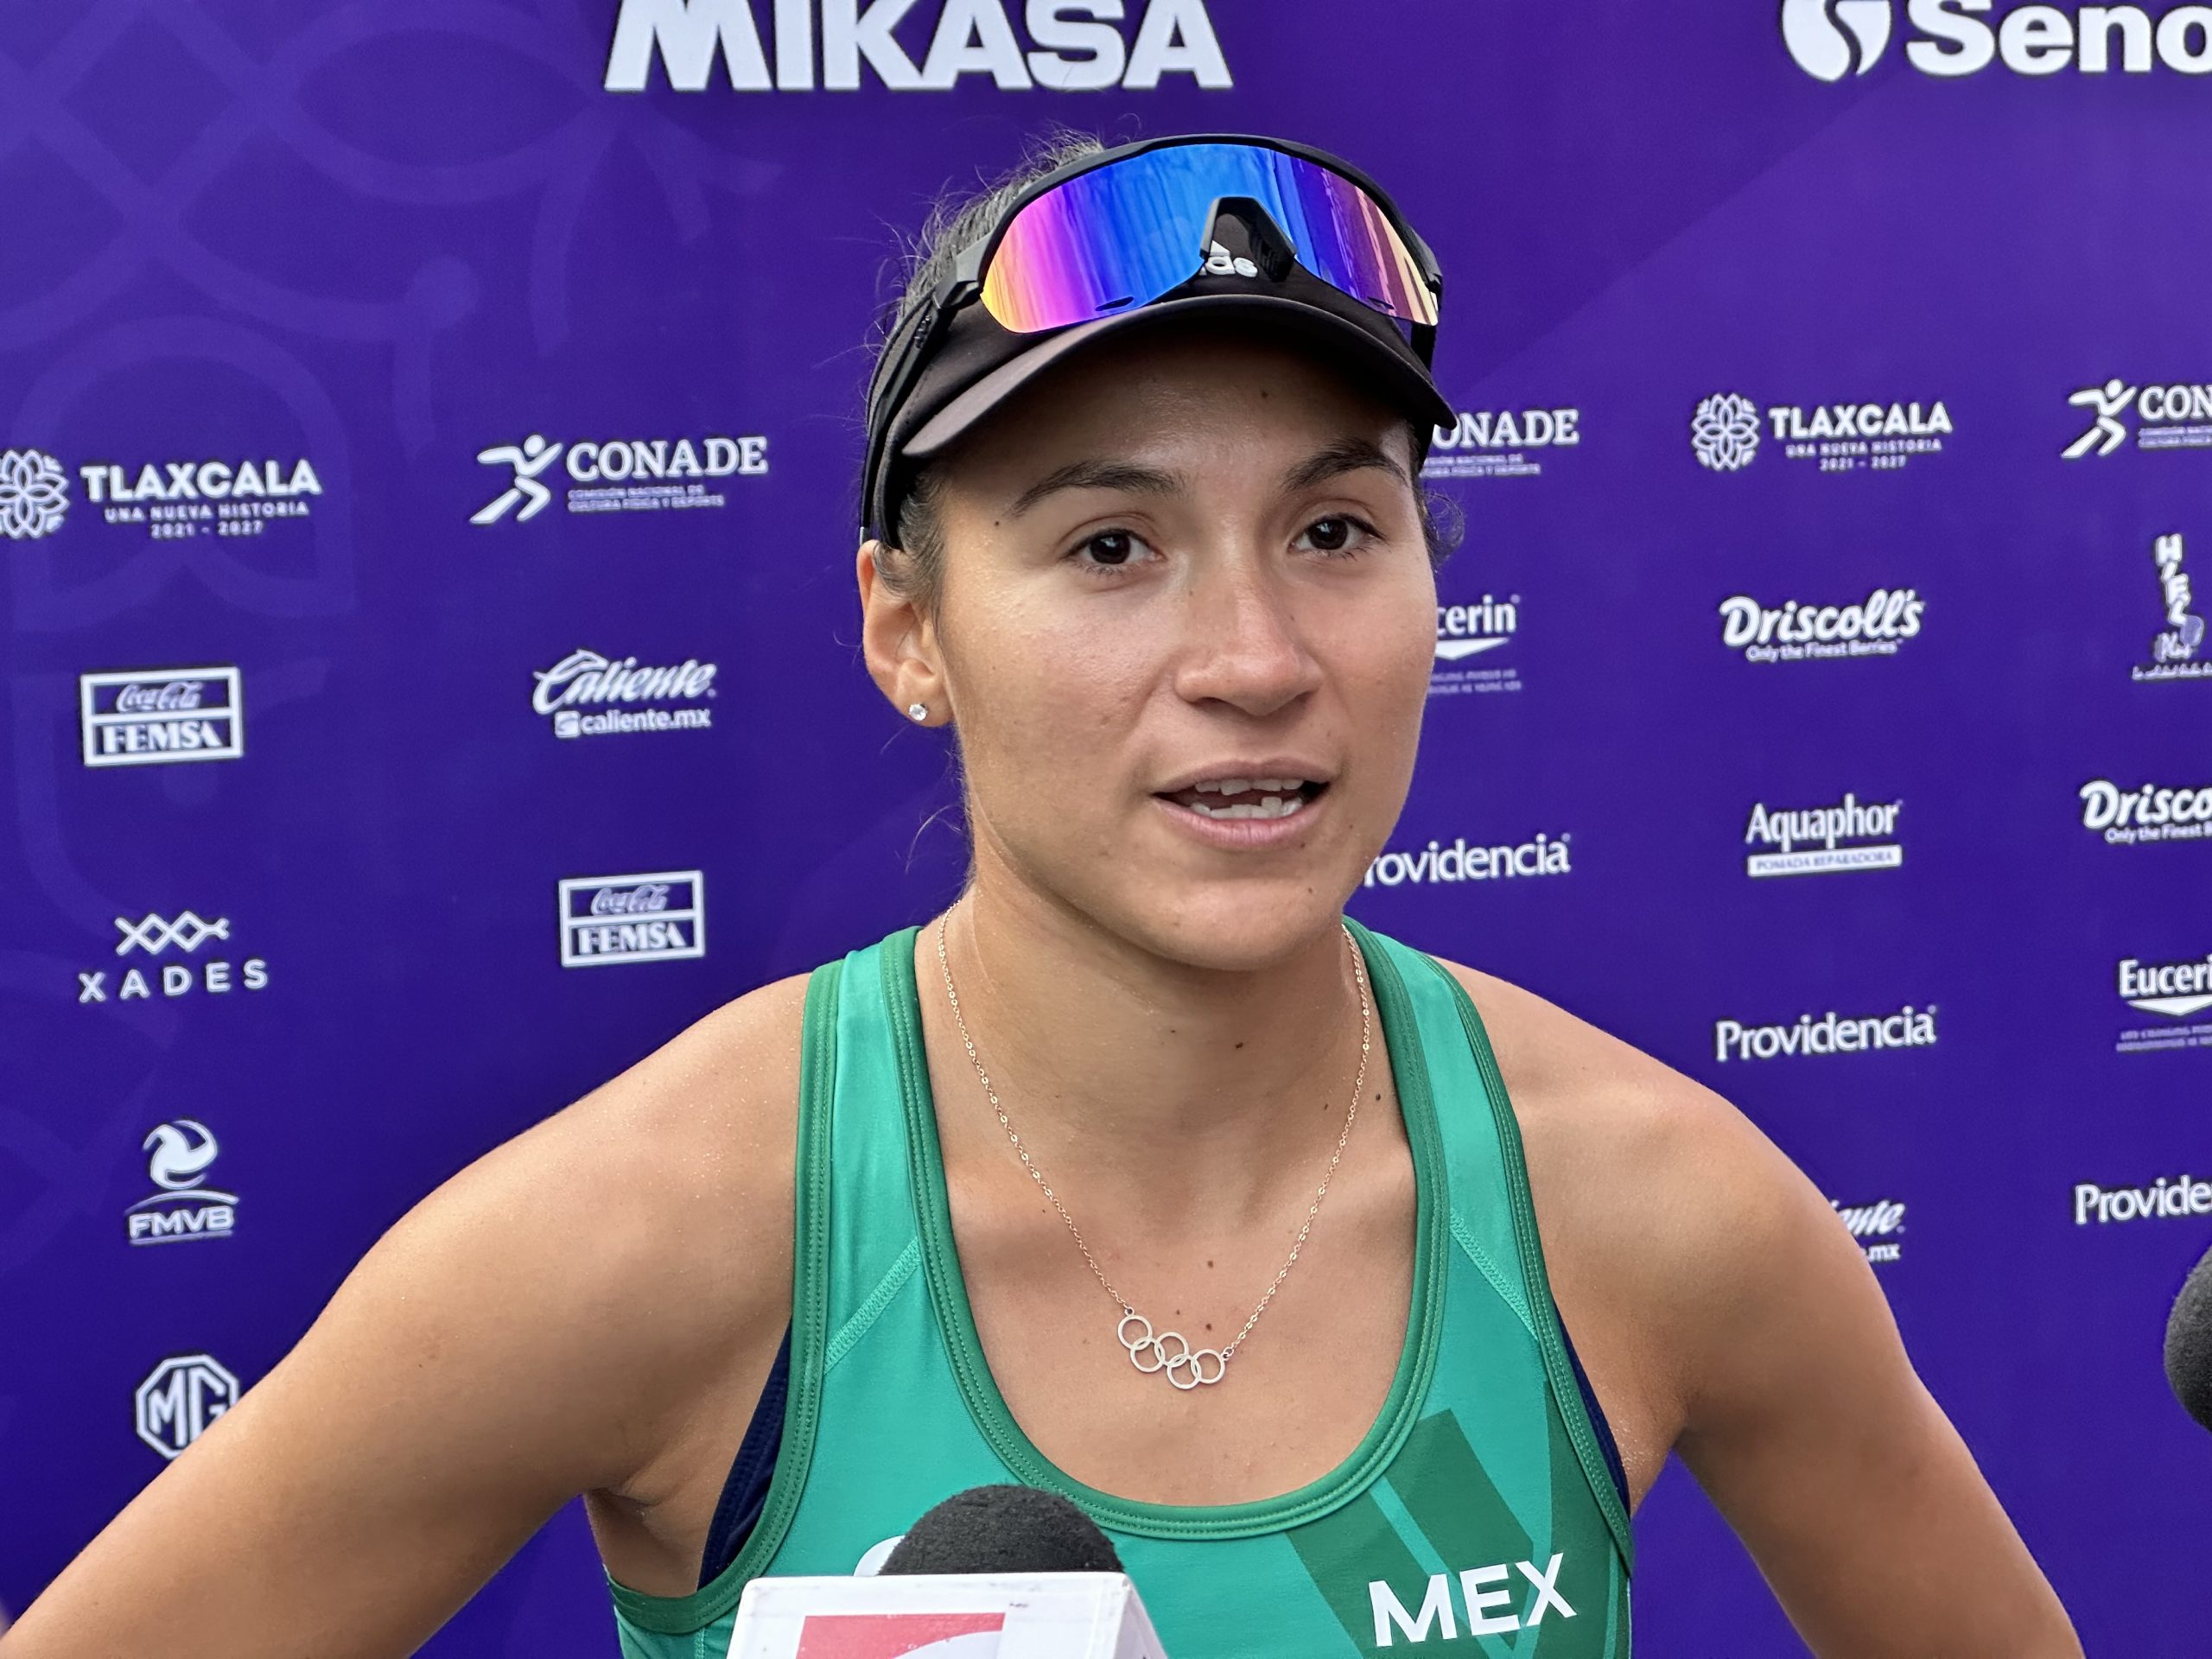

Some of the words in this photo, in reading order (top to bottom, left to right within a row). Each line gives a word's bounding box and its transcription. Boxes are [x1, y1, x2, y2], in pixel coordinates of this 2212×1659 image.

[604, 0, 1235, 91] MIKASA
[1906, 0, 2212, 76] Seno
[1769, 401, 1953, 440] TLAXCALA
[566, 436, 768, 481] CONADE
[80, 459, 322, 503] TLAXCALA
[104, 506, 145, 524] UNA
[149, 504, 213, 521] NUEVA
[218, 501, 309, 518] HISTORIA
[150, 523, 195, 538] 2021
[218, 520, 264, 536] 2027
[1719, 588, 1925, 646] Driscoll's
[532, 649, 717, 715] Caliente
[102, 721, 223, 754] FEMSA
[580, 709, 711, 734] caliente.mx
[1745, 792, 1900, 853] Aquaphor
[578, 921, 686, 955] FEMSA
[79, 959, 268, 1003] XADES
[1716, 1006, 1936, 1062] Providencia
[129, 1205, 234, 1238] FMVB
[148, 1368, 227, 1447] MG
[1369, 1553, 1578, 1647] MEX
